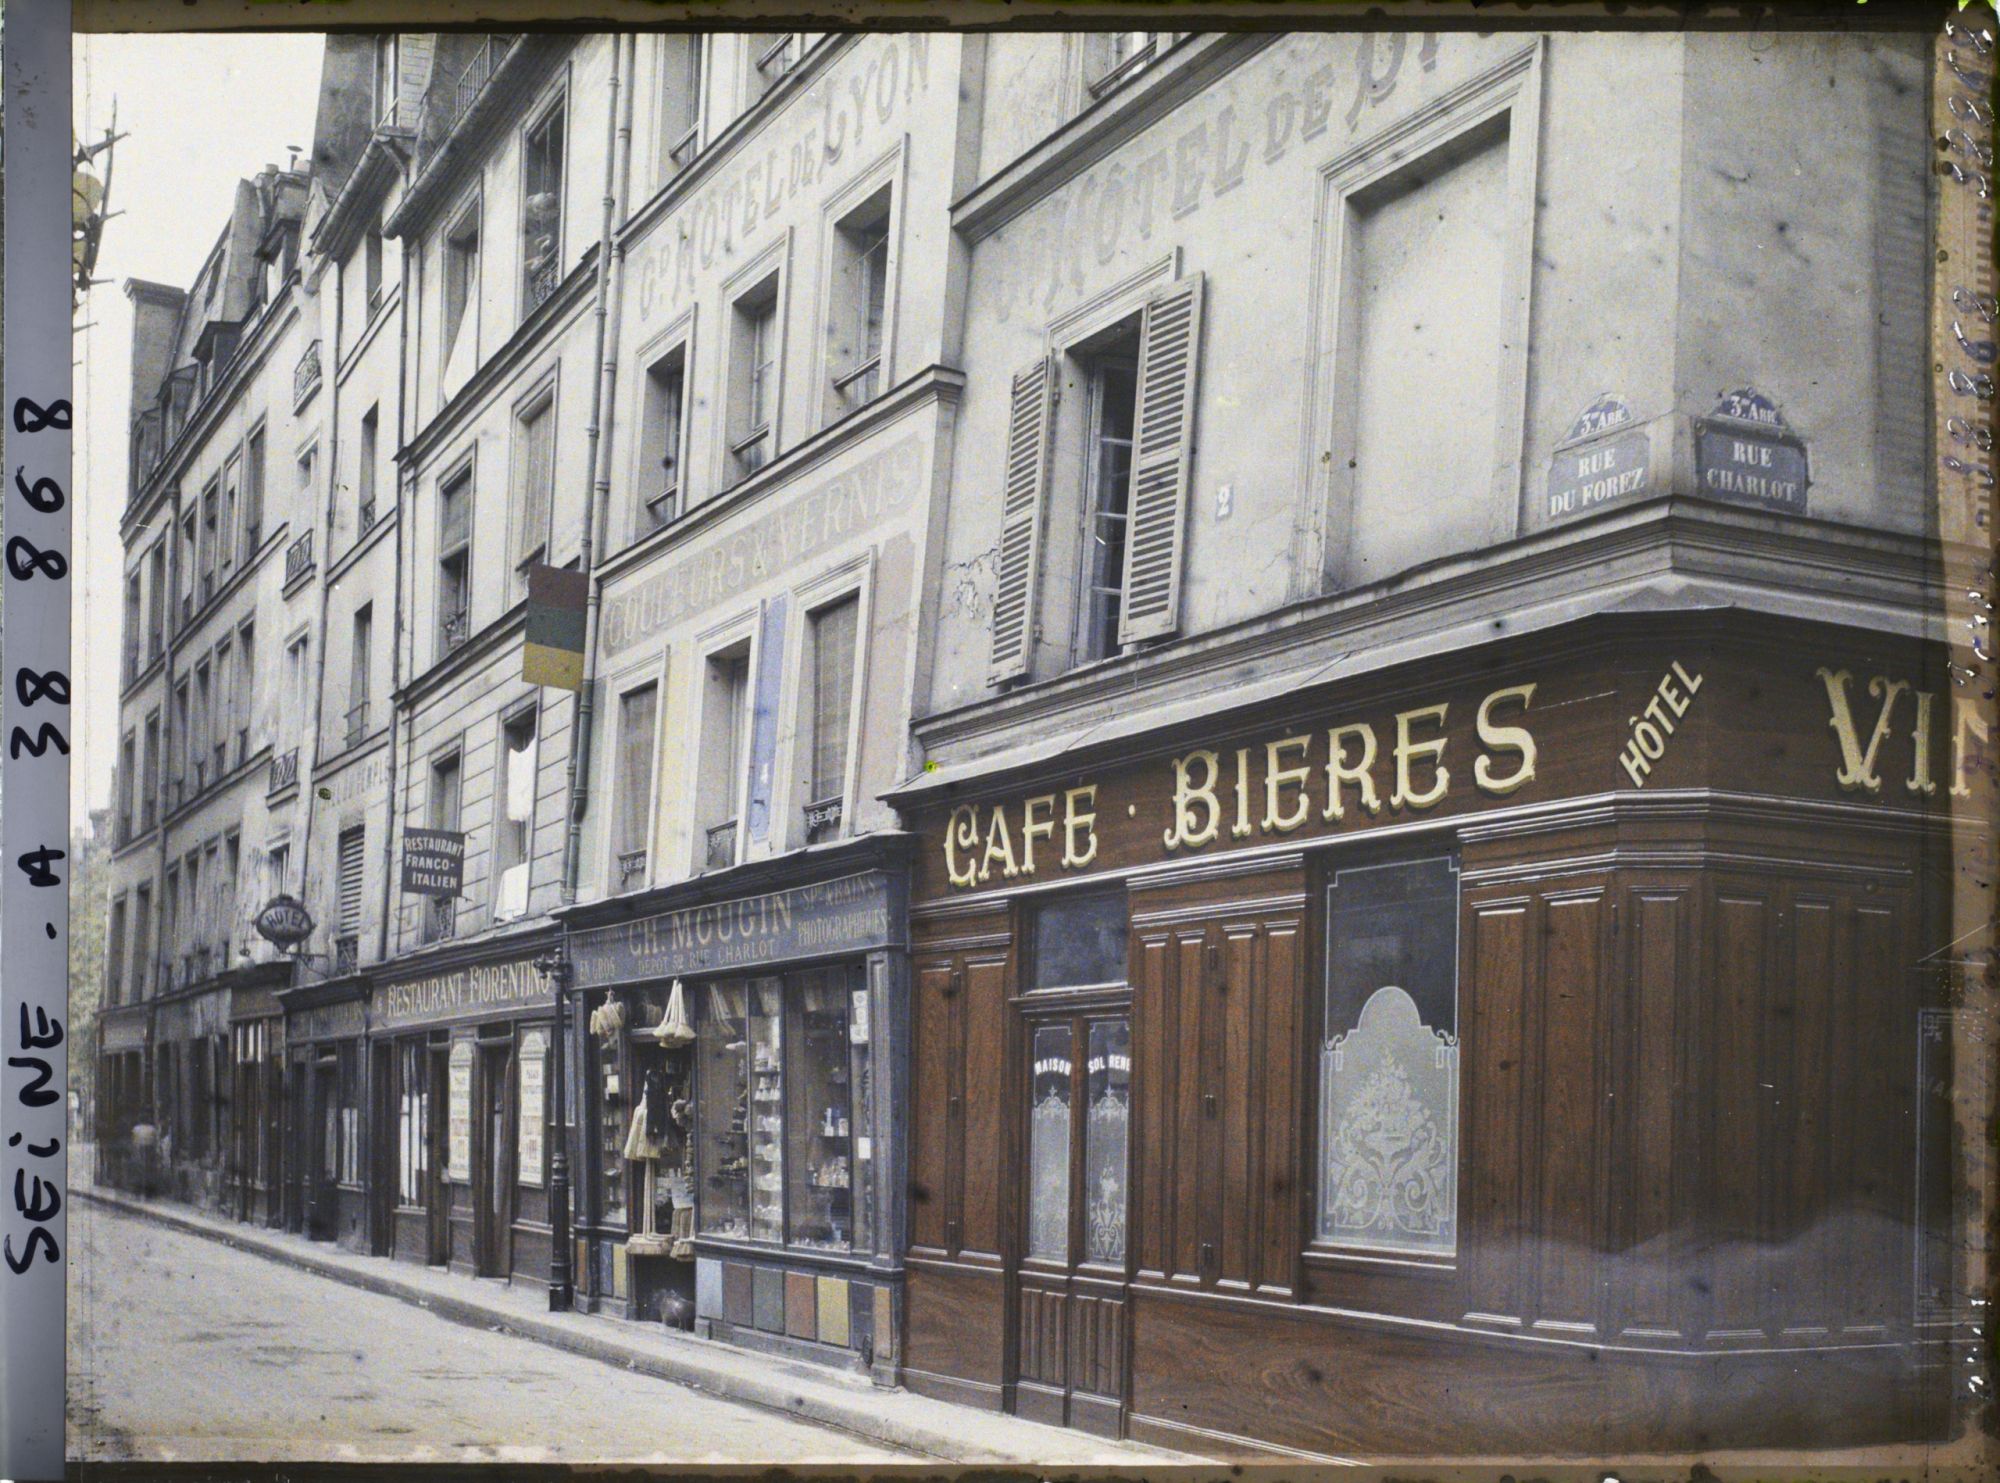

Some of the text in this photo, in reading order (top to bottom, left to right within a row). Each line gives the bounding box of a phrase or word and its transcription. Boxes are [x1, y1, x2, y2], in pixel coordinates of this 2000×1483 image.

[1264, 64, 1336, 167] DE
[1578, 448, 1616, 478] RUE
[1733, 442, 1772, 468] RUE
[1551, 468, 1645, 517] DU FOREZ
[1707, 468, 1796, 503] CHARLOT
[769, 446, 915, 565] VERNIS
[1619, 660, 1703, 788] HÔTEL
[404, 836, 464, 857] RESTAURANT
[405, 853, 455, 871] FRANCO-
[17, 845, 65, 887] A
[412, 871, 458, 889] ITALIEN
[671, 893, 793, 951] MOUGIN
[689, 949, 713, 970] RUE
[719, 938, 777, 967] CHARLOT
[387, 972, 464, 1018] RESTAURANT
[1034, 1057, 1072, 1076] MAISON
[1088, 1055, 1105, 1075] SOL
